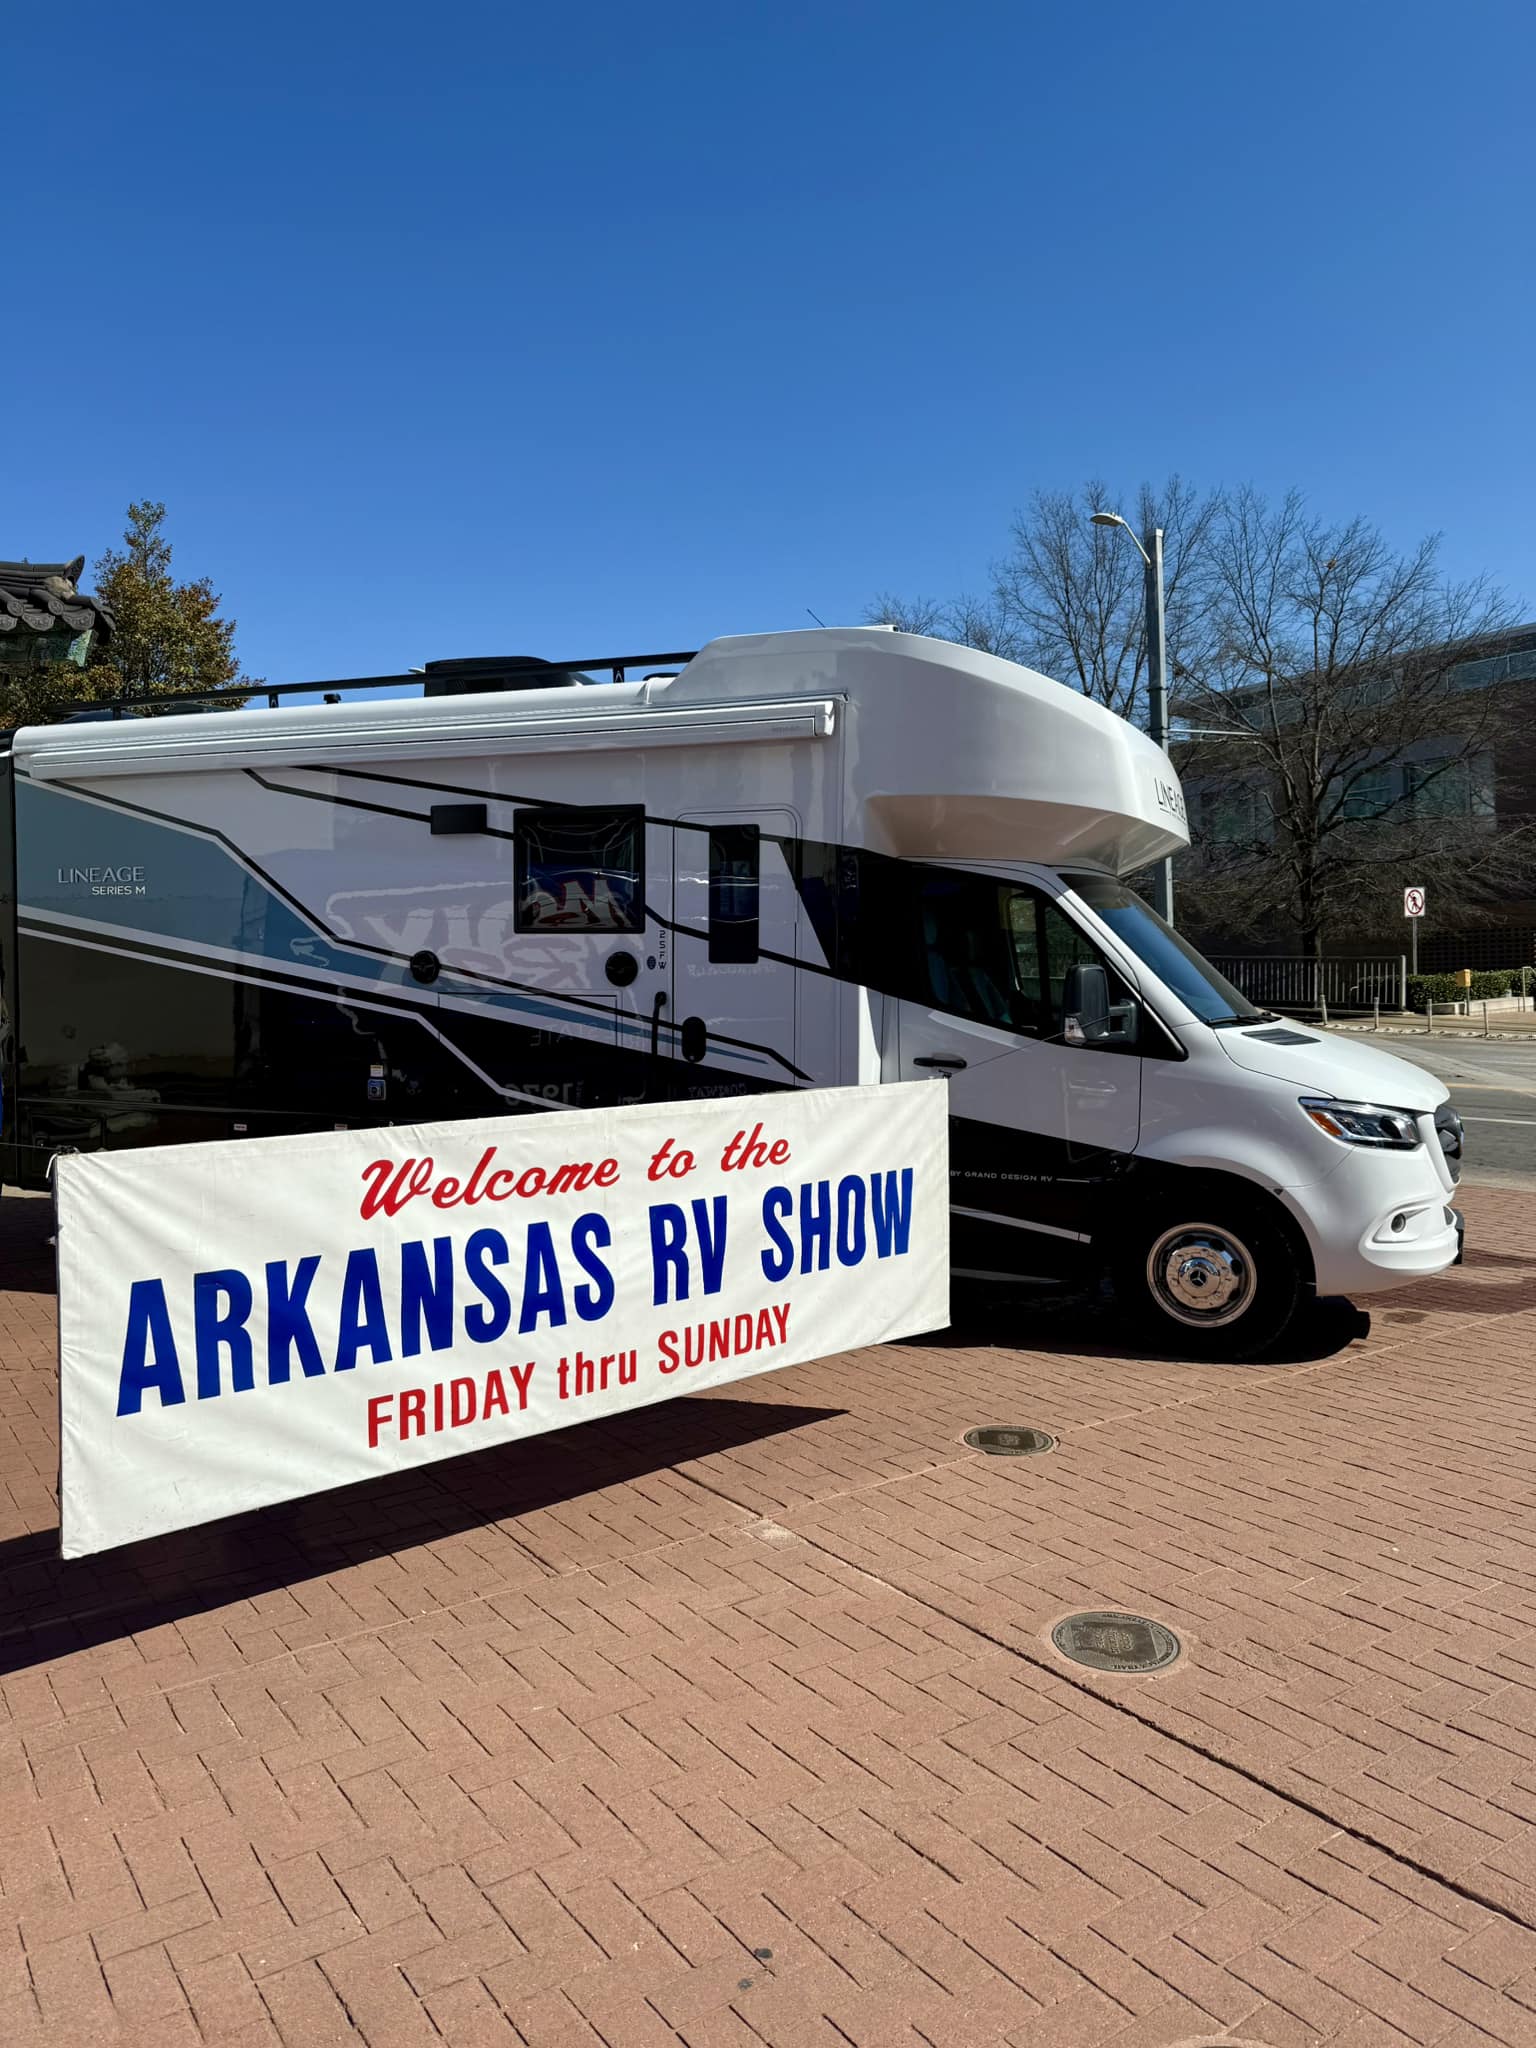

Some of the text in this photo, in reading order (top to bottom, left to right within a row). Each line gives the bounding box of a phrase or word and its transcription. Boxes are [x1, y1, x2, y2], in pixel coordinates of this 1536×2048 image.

[58, 866, 145, 883] LINEAGE
[91, 885, 146, 896] SERIES M
[360, 1122, 790, 1221] Welcome to the
[964, 1171, 998, 1179] GRAND
[1001, 1173, 1037, 1181] DESIGN
[118, 1167, 913, 1417] ARKANSAS RV SHOW
[368, 1302, 791, 1448] FRIDAY thru SUNDAY
